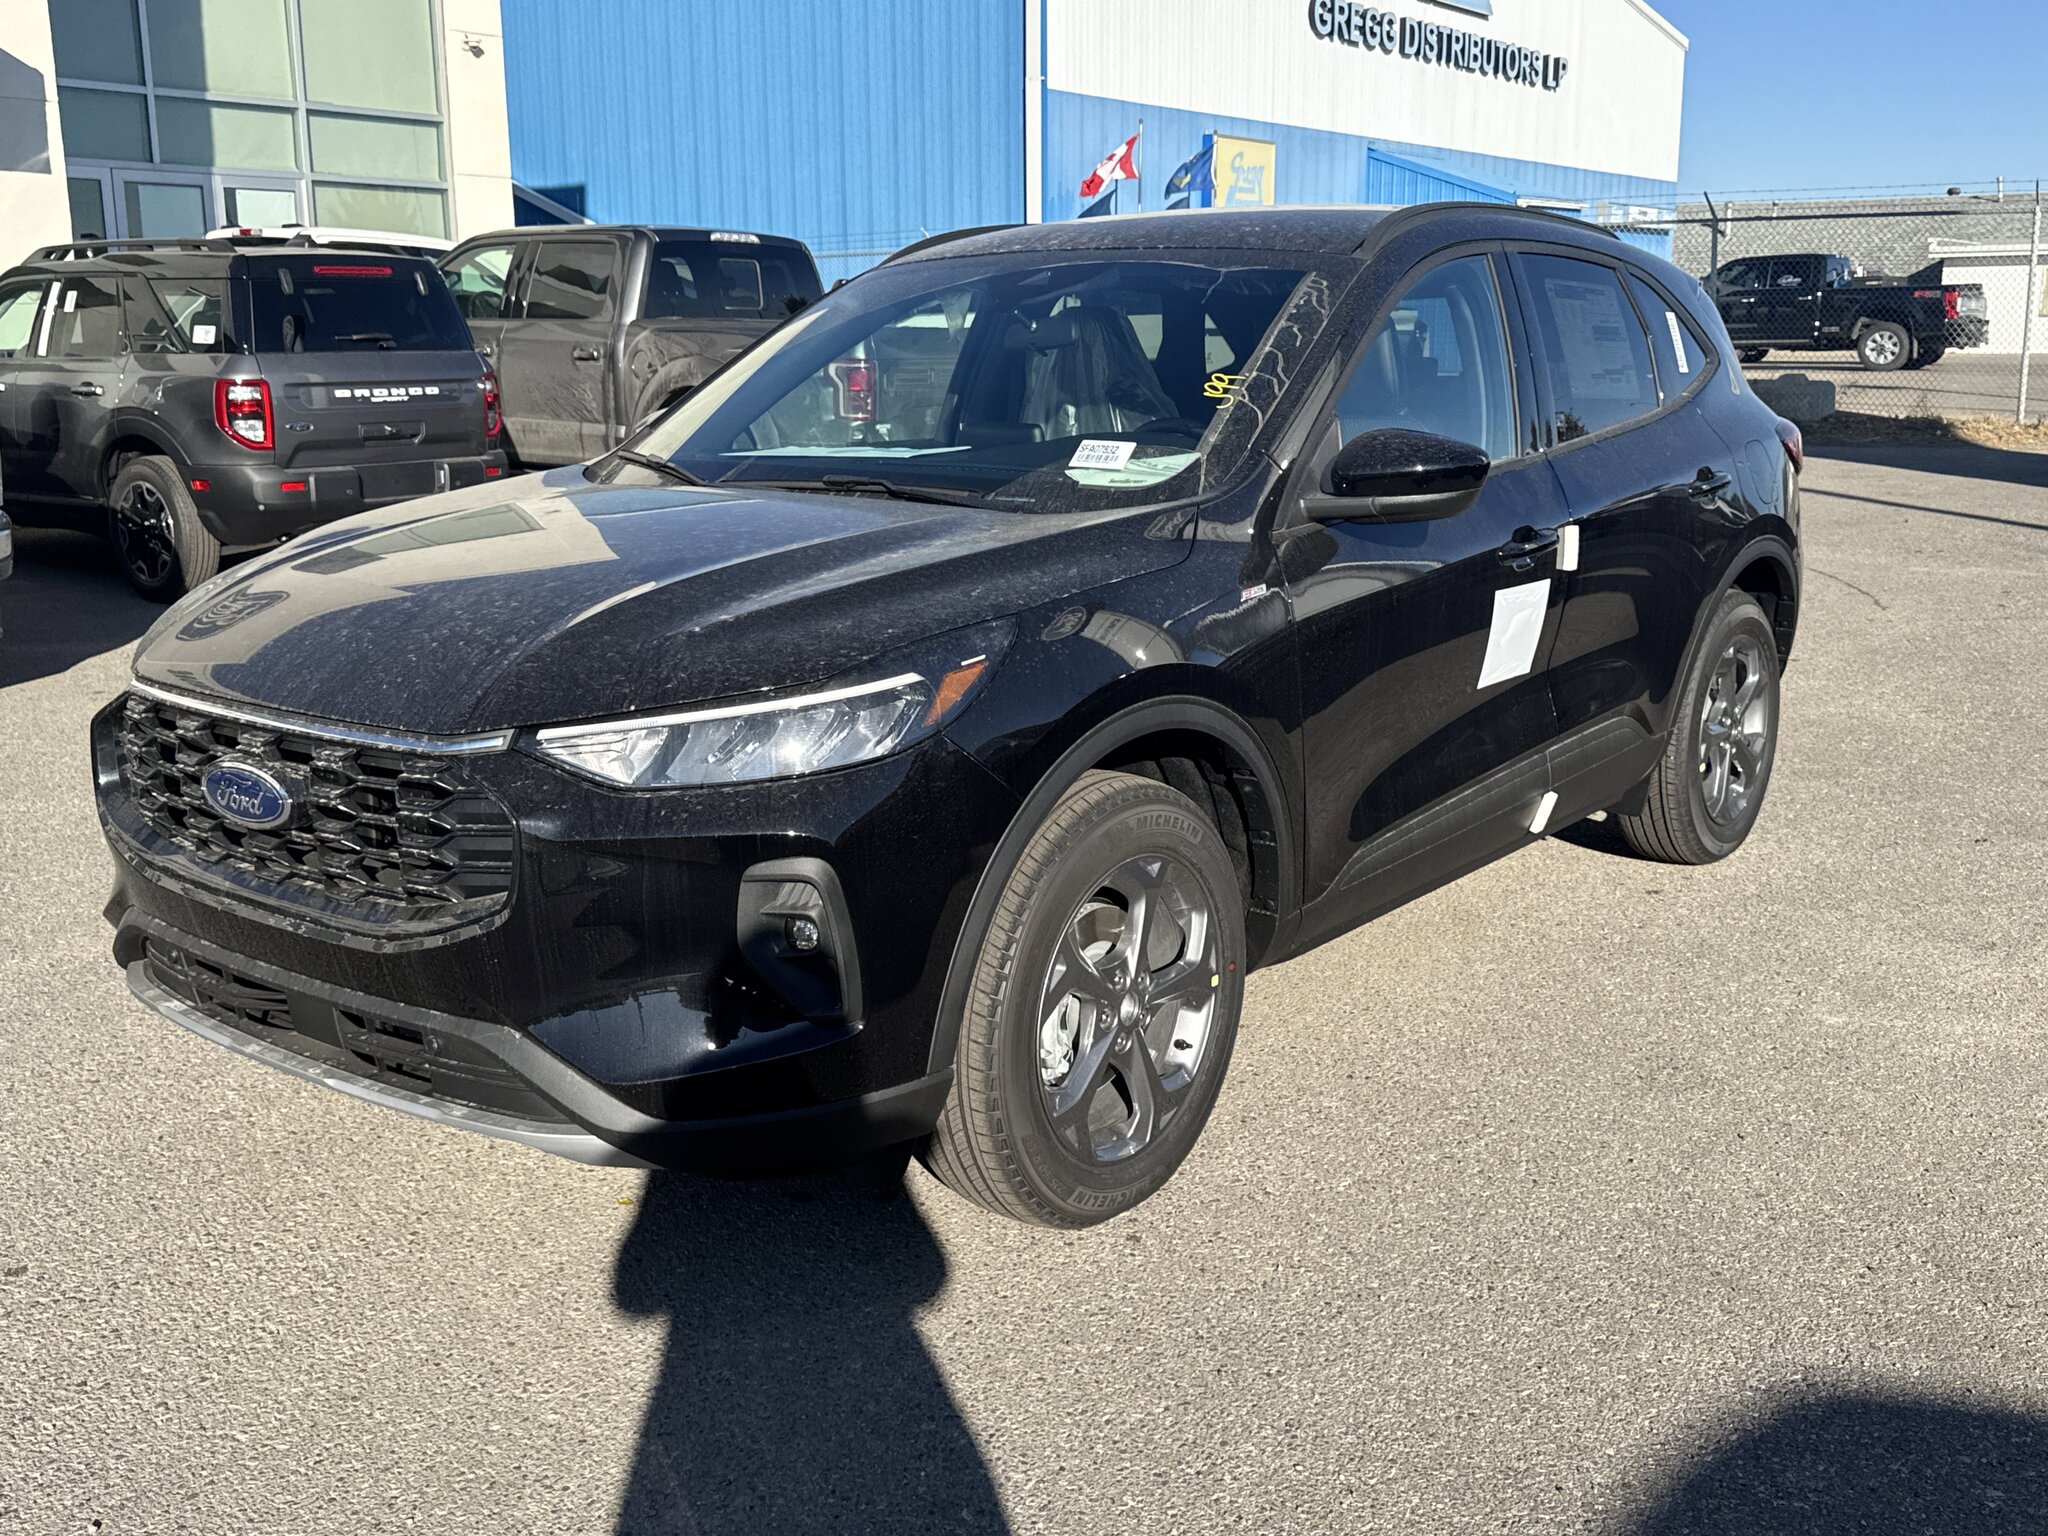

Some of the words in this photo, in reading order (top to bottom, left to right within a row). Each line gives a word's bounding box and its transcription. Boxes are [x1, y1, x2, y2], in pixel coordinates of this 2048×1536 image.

[1309, 0, 1397, 53] GREGG
[1400, 17, 1541, 87] DISTRIBUTORS
[1542, 54, 1569, 92] LP
[334, 386, 440, 398] BRONCO
[216, 774, 264, 815] Ford
[1137, 814, 1200, 838] MICHELIN
